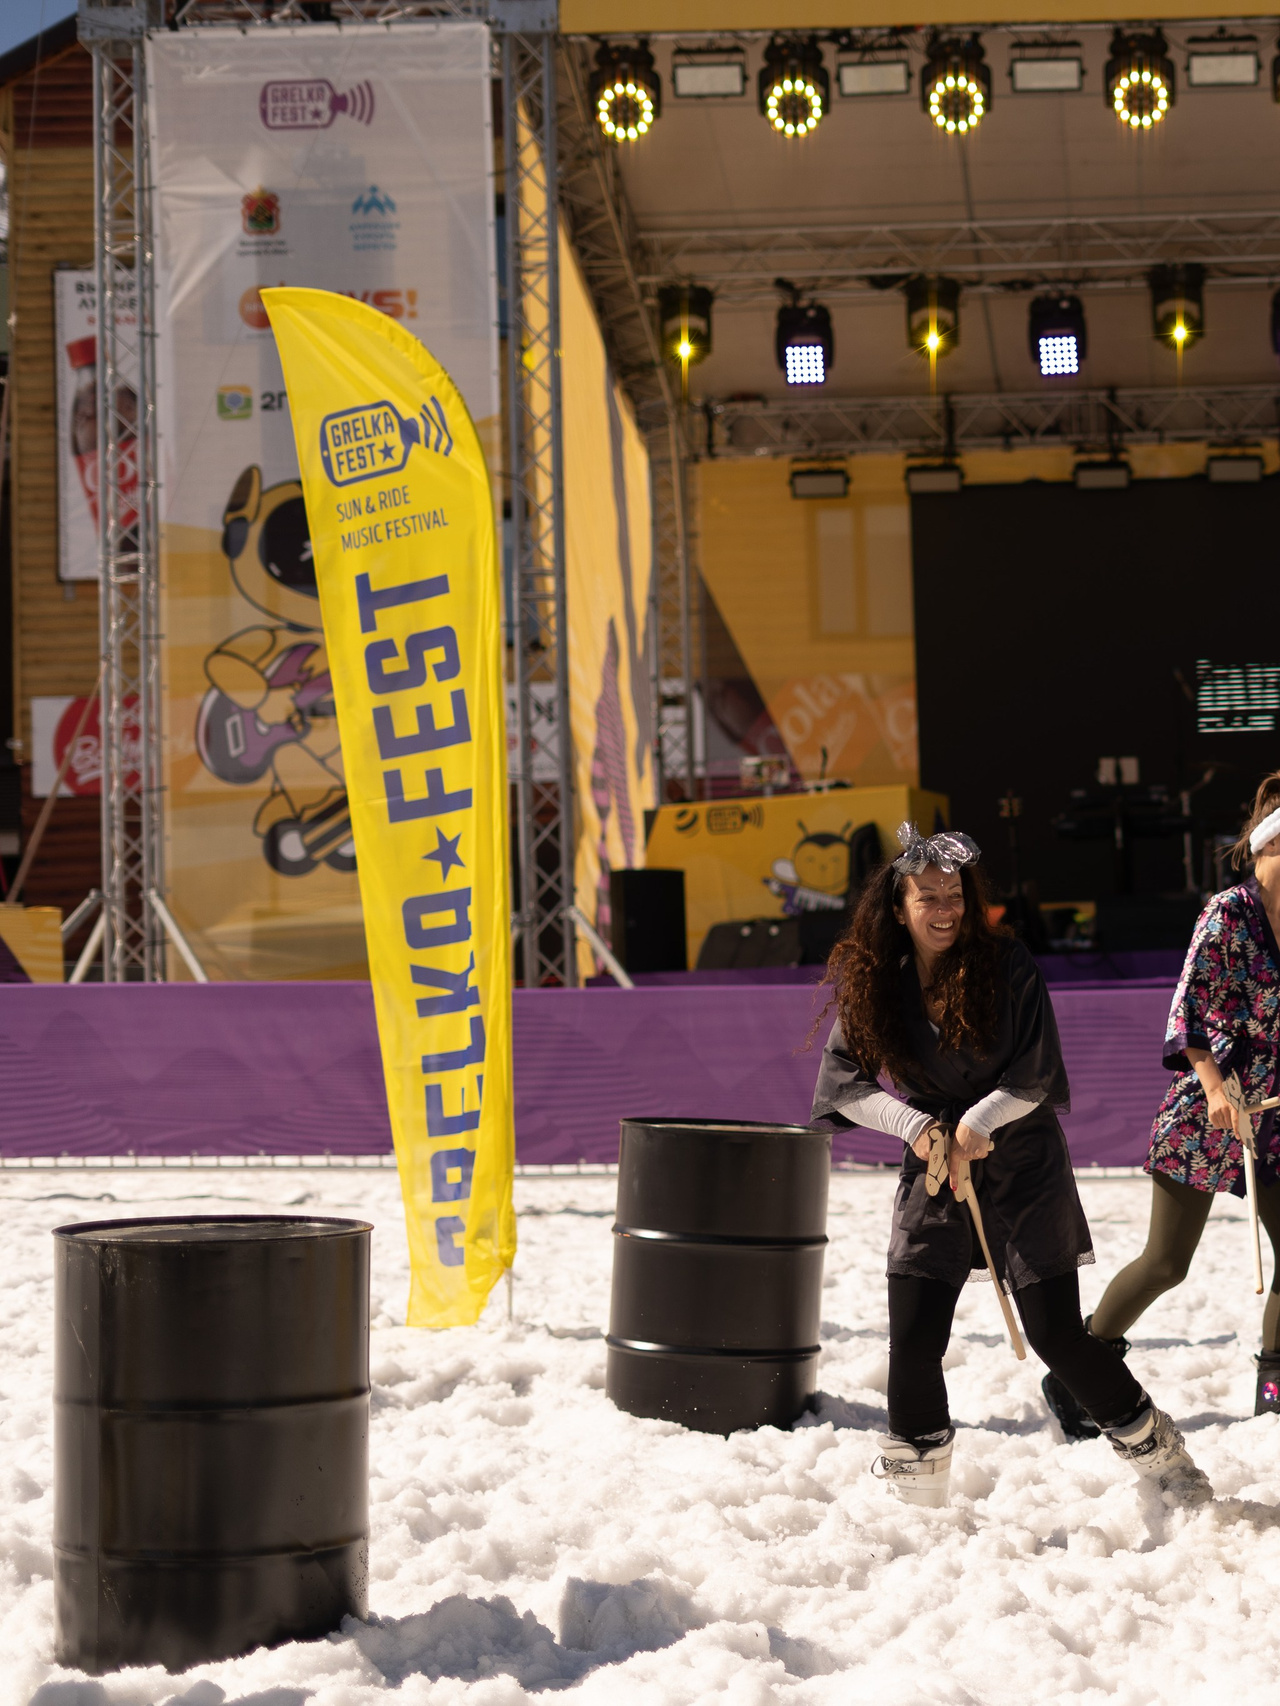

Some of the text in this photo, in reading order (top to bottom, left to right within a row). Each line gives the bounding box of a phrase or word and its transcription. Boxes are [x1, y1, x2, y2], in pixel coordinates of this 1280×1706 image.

[271, 86, 325, 103] GRELKA
[272, 105, 306, 122] FEST
[331, 411, 395, 448] GRELKA
[336, 443, 376, 476] FEST
[336, 484, 411, 523] SUN & RIDE
[341, 508, 449, 552] MUSIC FESTIVAL
[355, 572, 473, 824] FEST
